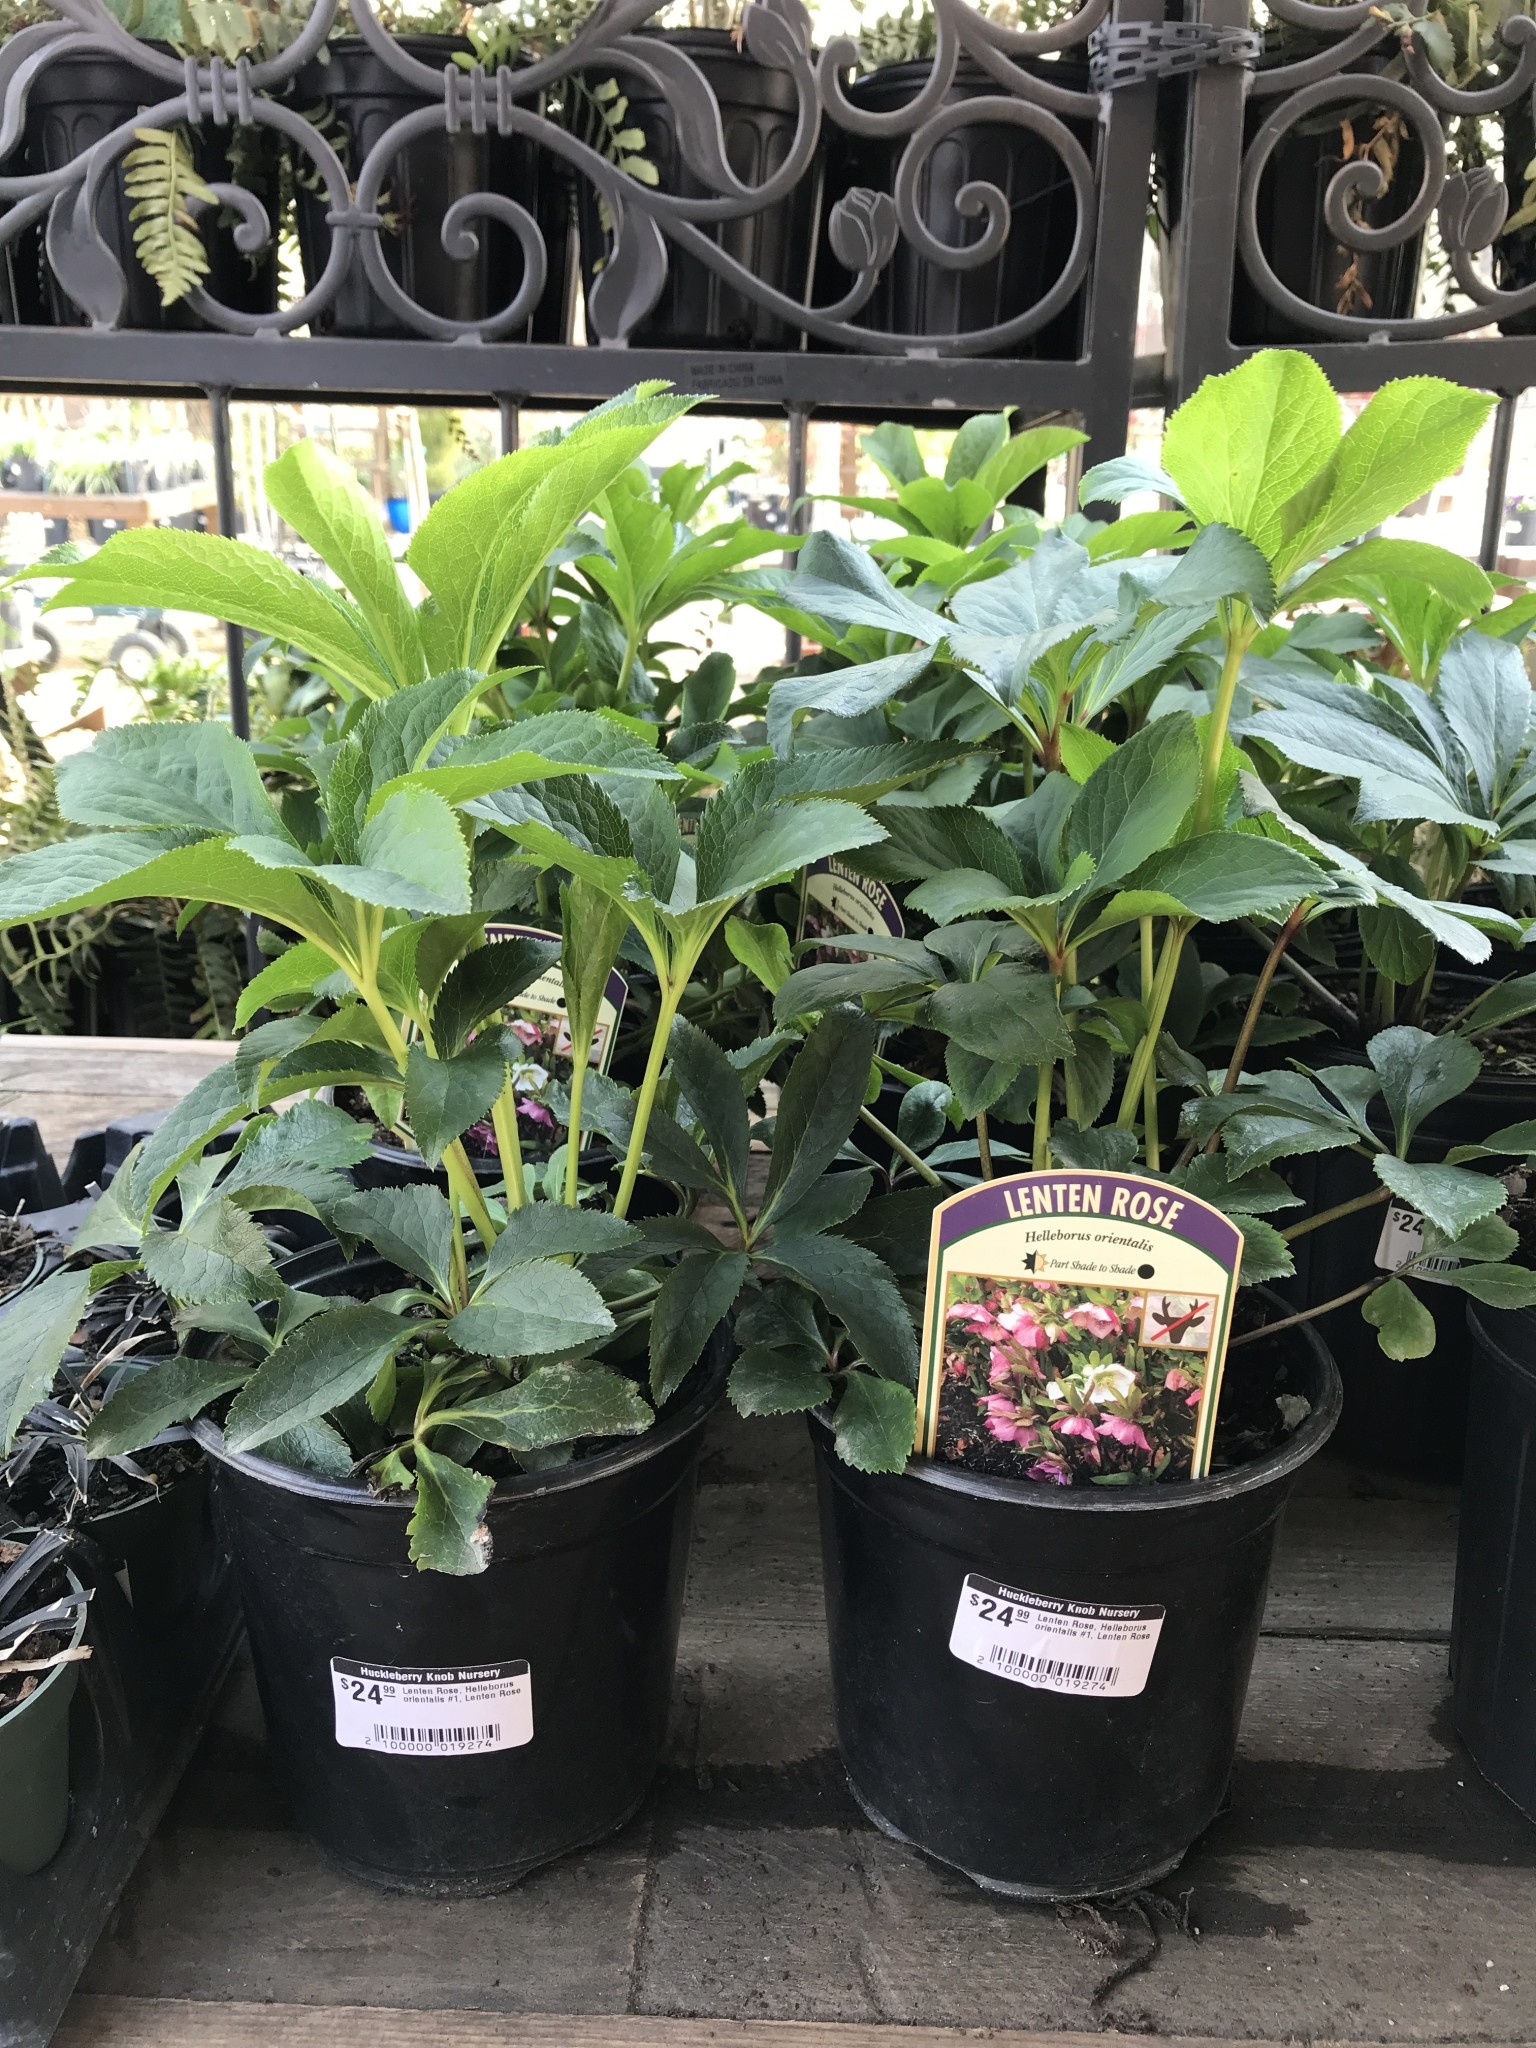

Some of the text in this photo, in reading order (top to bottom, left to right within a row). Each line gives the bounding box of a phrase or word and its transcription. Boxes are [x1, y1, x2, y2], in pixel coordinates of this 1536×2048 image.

[862, 878, 887, 911] ROSE
[1004, 1183, 1185, 1230] LENTEN ROSE
[1025, 1229, 1154, 1252] Helleborus orientalis
[1050, 1259, 1136, 1275] Part Shade to Shade
[998, 1586, 1141, 1619] Huckleberry Knob Nursery
[1037, 1614, 1068, 1626] Lenten
[1101, 1623, 1147, 1631] Helleborus
[1034, 1623, 1077, 1637] orientalis
[1097, 1632, 1127, 1640] Lenten
[361, 1667, 500, 1683] Huckleberry Knob Nursery
[402, 1687, 433, 1695] Lenten
[465, 1681, 514, 1693] Helleborus
[1055, 1677, 1106, 1691] 019274
[403, 1695, 445, 1703] orientalis
[465, 1692, 496, 1702] Lenten
[499, 1688, 521, 1697] Rose
[440, 1739, 492, 1751] 019274
